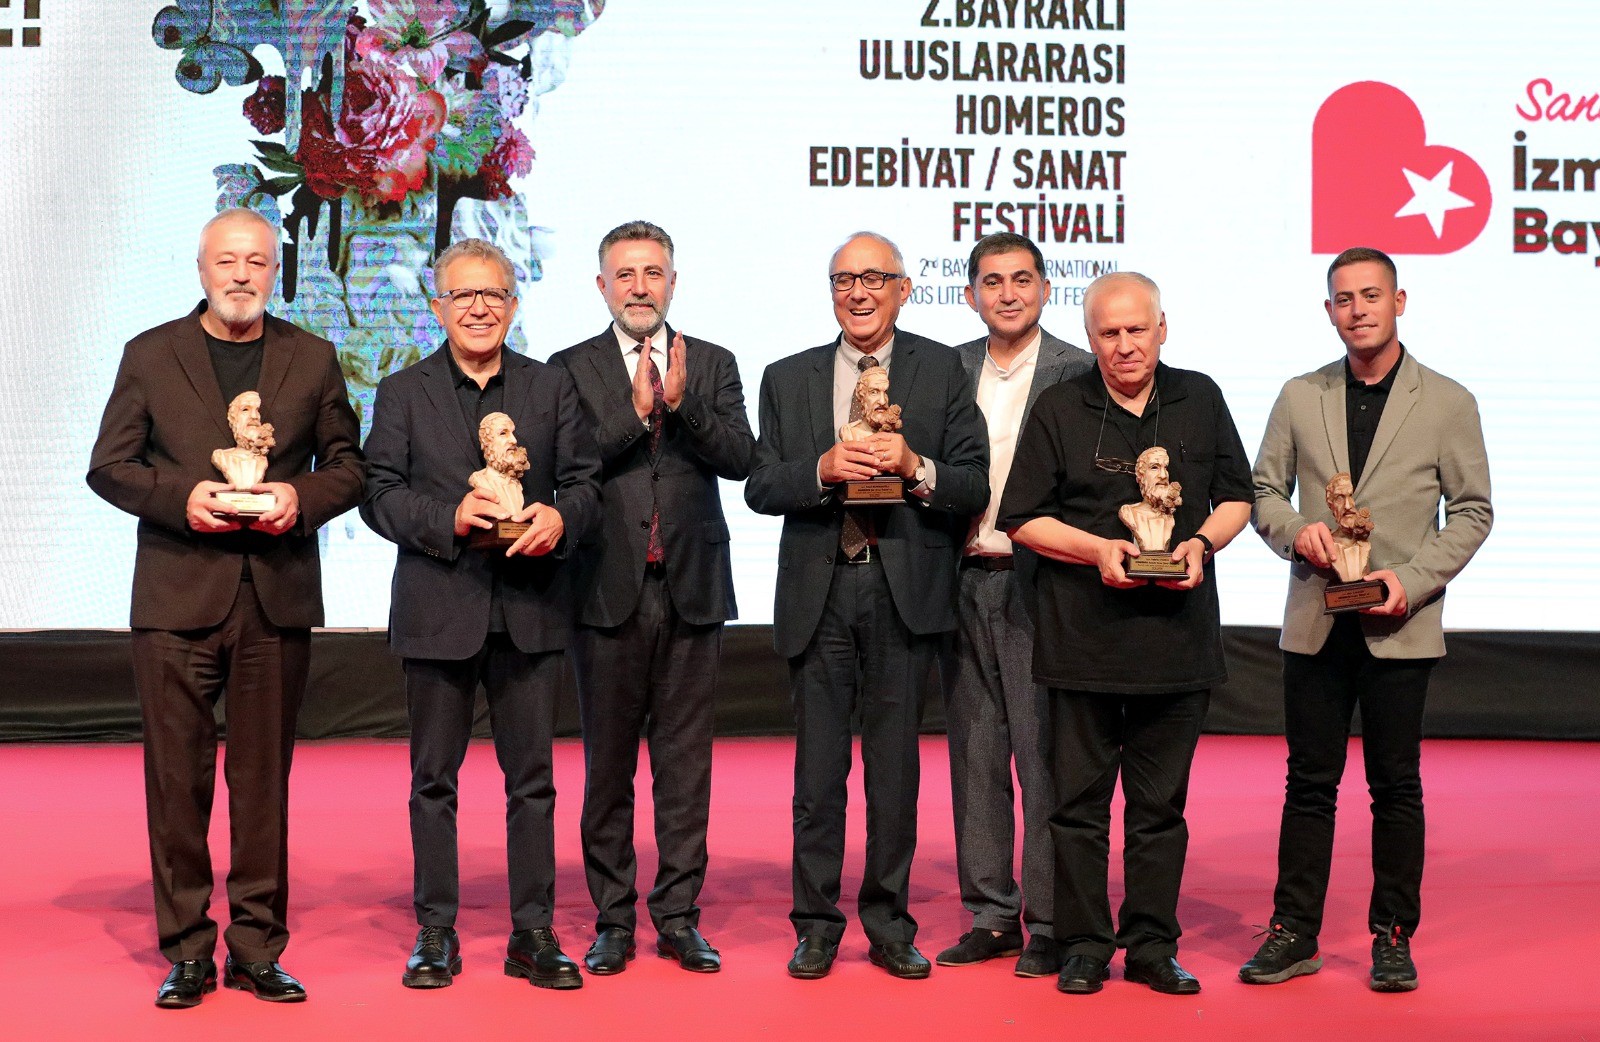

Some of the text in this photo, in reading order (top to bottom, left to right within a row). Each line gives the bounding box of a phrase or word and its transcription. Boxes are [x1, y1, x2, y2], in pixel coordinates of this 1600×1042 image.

[860, 40, 1125, 83] ULUSLARARASI
[956, 95, 1124, 137] HOMEROS
[1516, 78, 1600, 121] San
[810, 138, 1126, 191] EDEBİYAT / SANAT
[953, 194, 1124, 243] FESTİVALİ
